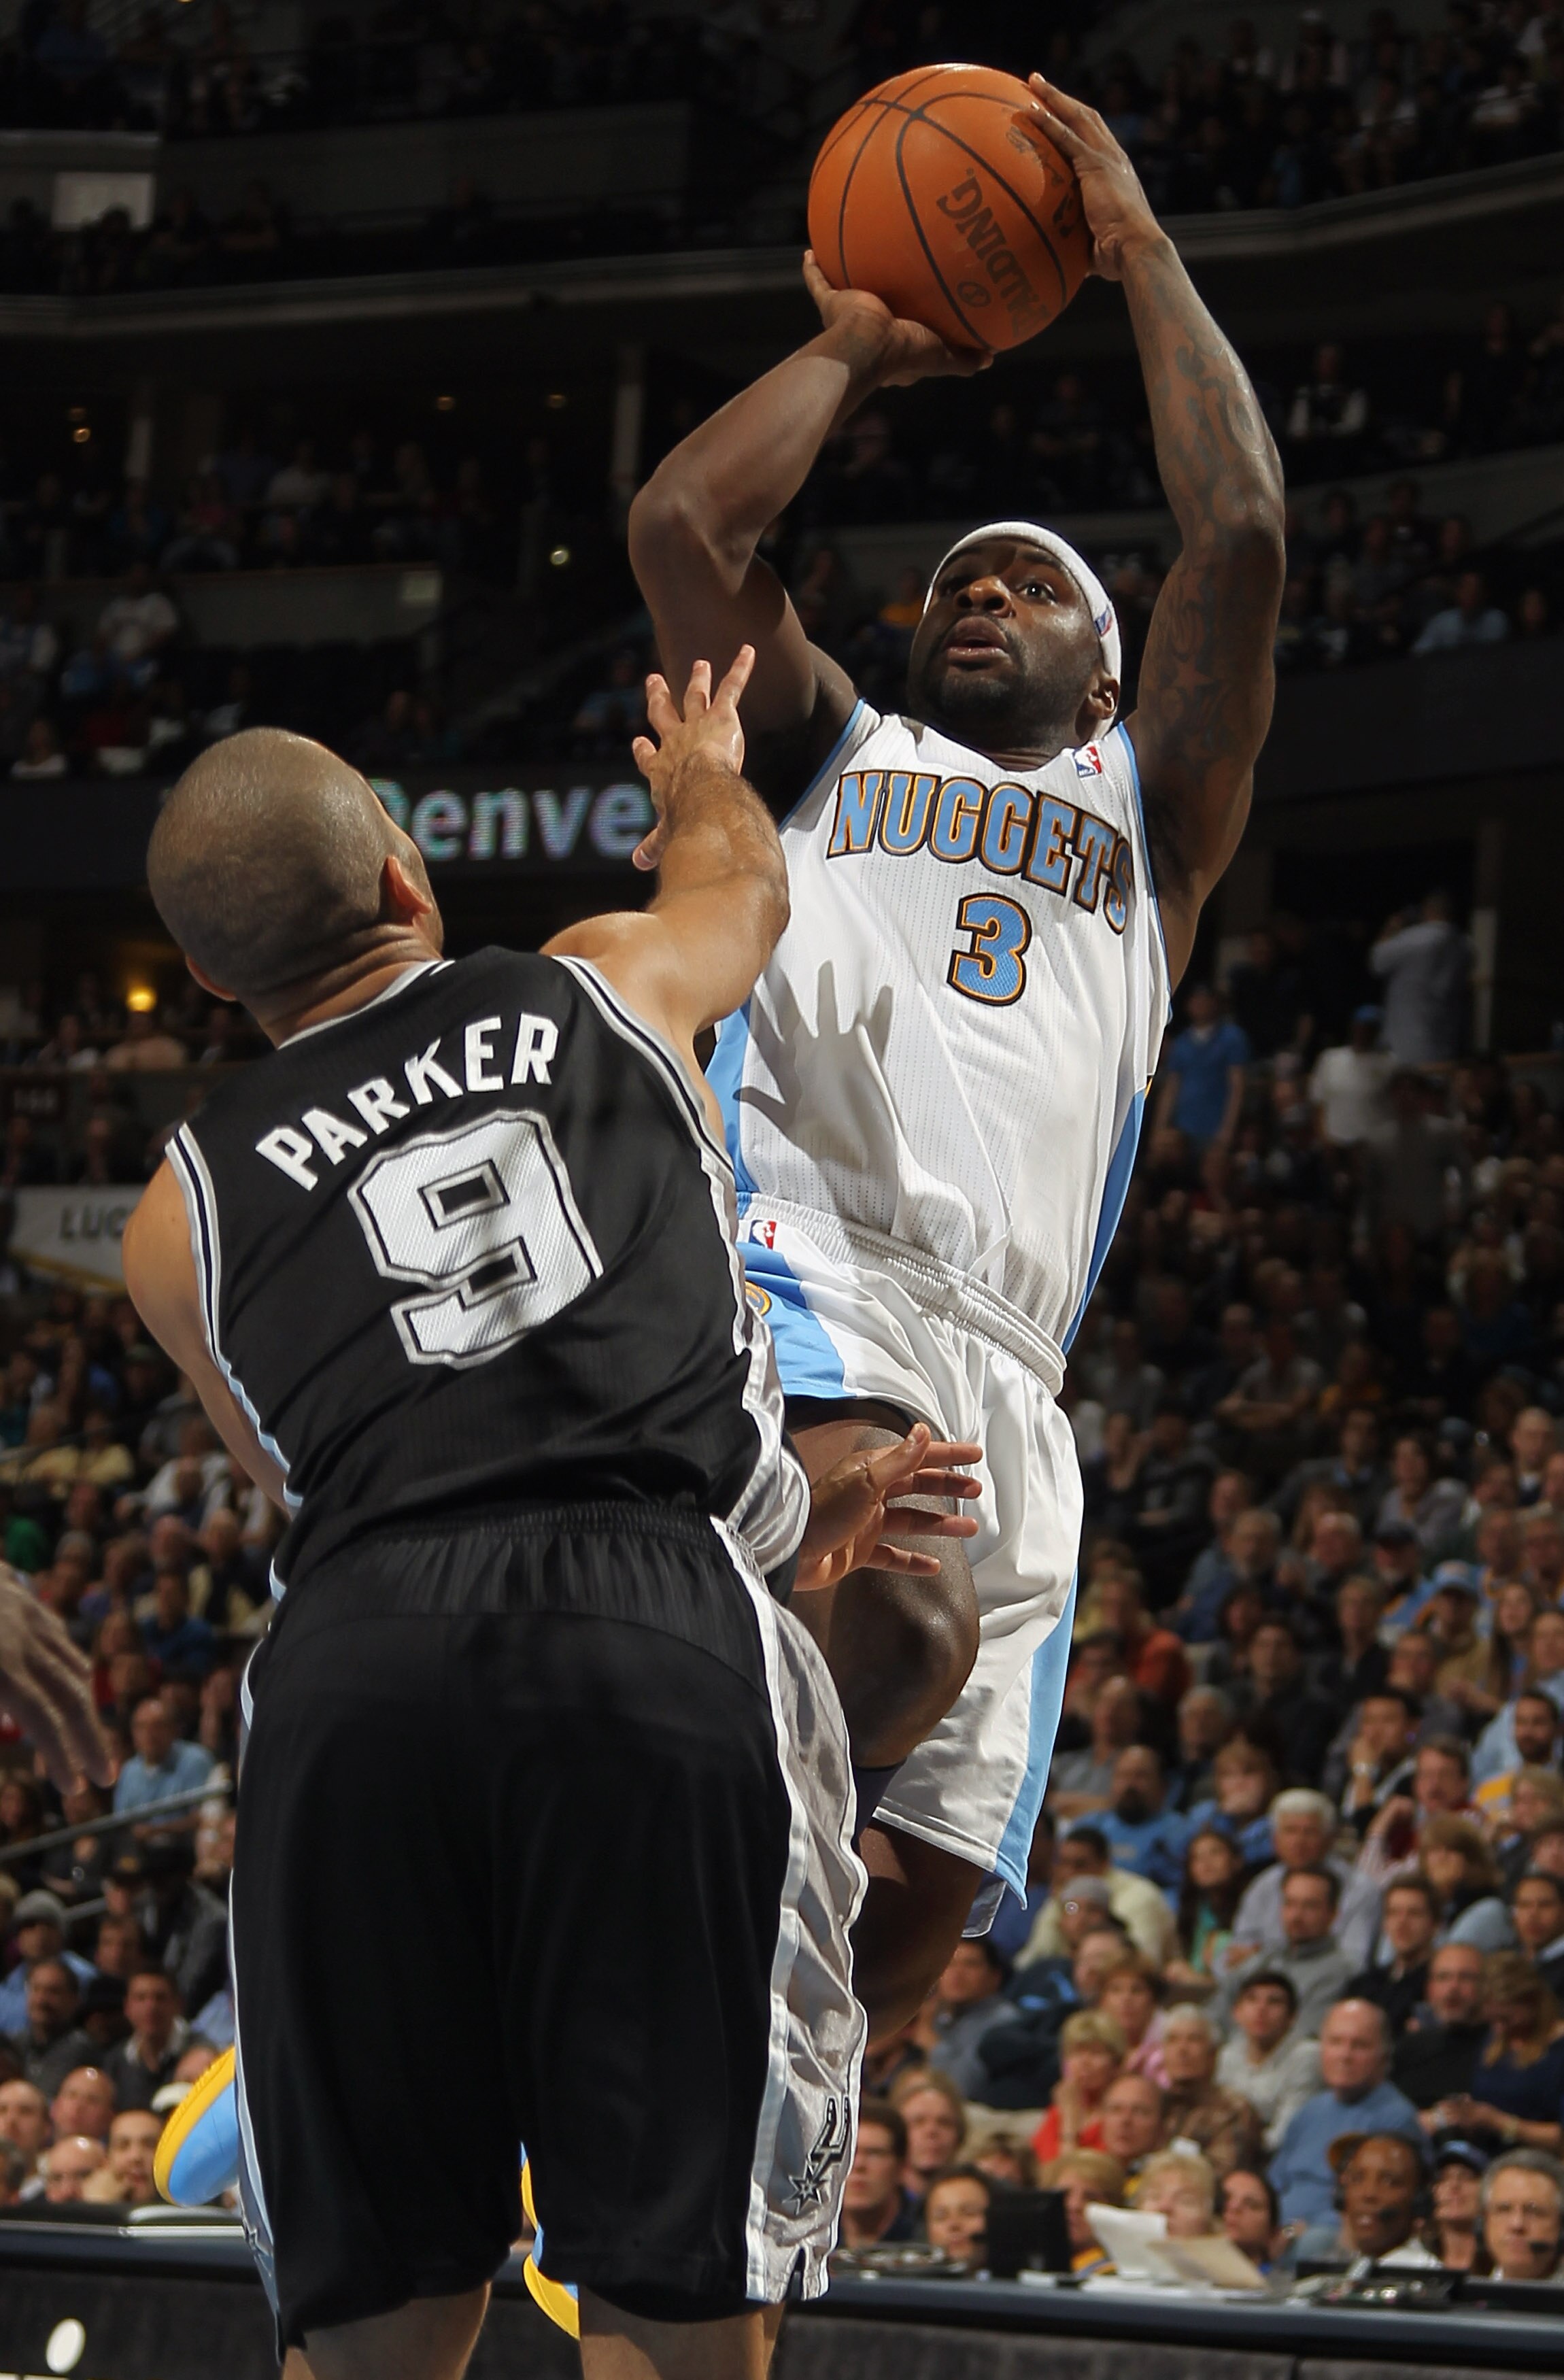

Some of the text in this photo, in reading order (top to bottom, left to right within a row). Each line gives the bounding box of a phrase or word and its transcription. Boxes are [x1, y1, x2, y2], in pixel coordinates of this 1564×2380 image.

[936, 176, 1051, 338] PALDING
[826, 770, 1134, 934] NUGGETS
[947, 892, 1032, 1006] 3
[256, 1012, 559, 1191] PARKER
[347, 1108, 604, 1370] 9
